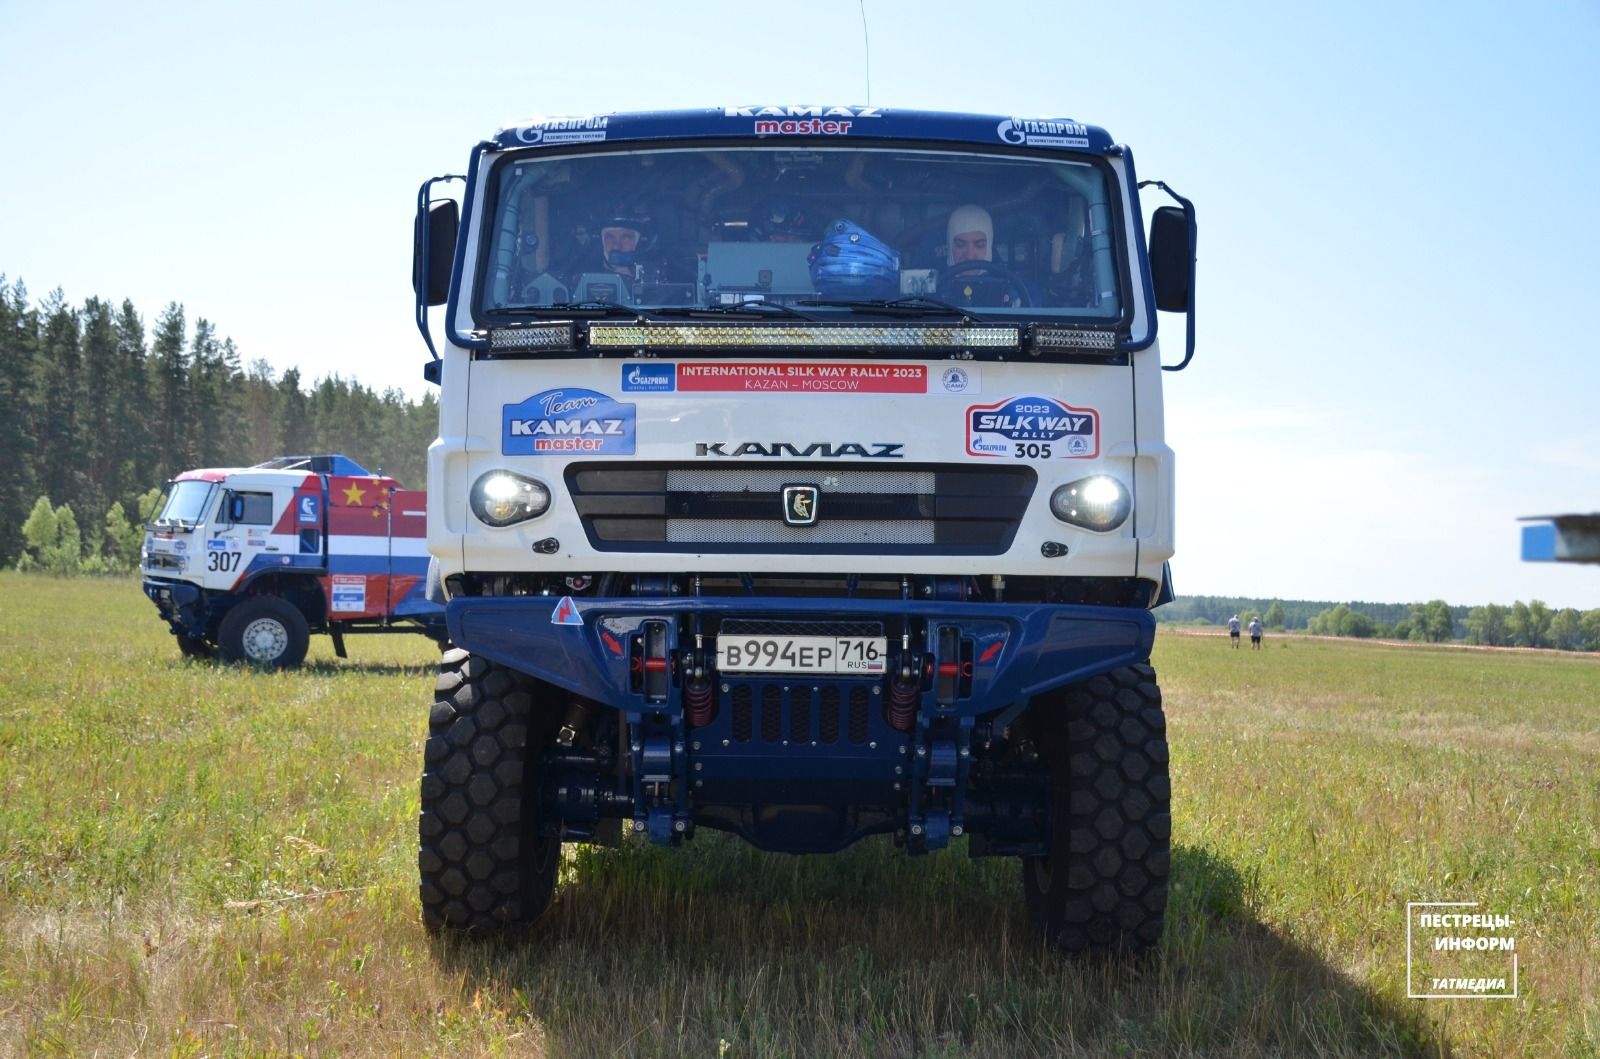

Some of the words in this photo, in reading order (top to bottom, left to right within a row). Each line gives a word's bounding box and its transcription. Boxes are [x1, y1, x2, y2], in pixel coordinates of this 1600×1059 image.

[725, 105, 882, 118] KAMAZ
[755, 118, 852, 135] master
[1024, 121, 1088, 136] ГАЗПРОМ
[682, 366, 784, 376] INTERNATIONAL
[787, 366, 815, 376] SILK
[818, 367, 846, 377] WAY
[850, 367, 890, 378] RALLY
[893, 368, 922, 378] 2023
[640, 376, 669, 385] GAZPROM
[745, 379, 788, 389] KAZAN
[802, 380, 860, 390] MOSCOW
[540, 391, 599, 417] Team
[1015, 405, 1050, 413] 2023
[511, 419, 624, 436] KAMAZ
[978, 415, 1036, 430] SILK
[1038, 416, 1088, 431] WAY
[1011, 431, 1055, 439] RALLY
[534, 437, 603, 451] master
[695, 441, 904, 458] KAMAZ
[982, 444, 1007, 452] GAZPROM
[1014, 443, 1052, 459] 305
[208, 551, 242, 572] 307
[726, 640, 832, 667] В994ЕР
[838, 640, 879, 661] 716
[847, 661, 867, 669] RUS
